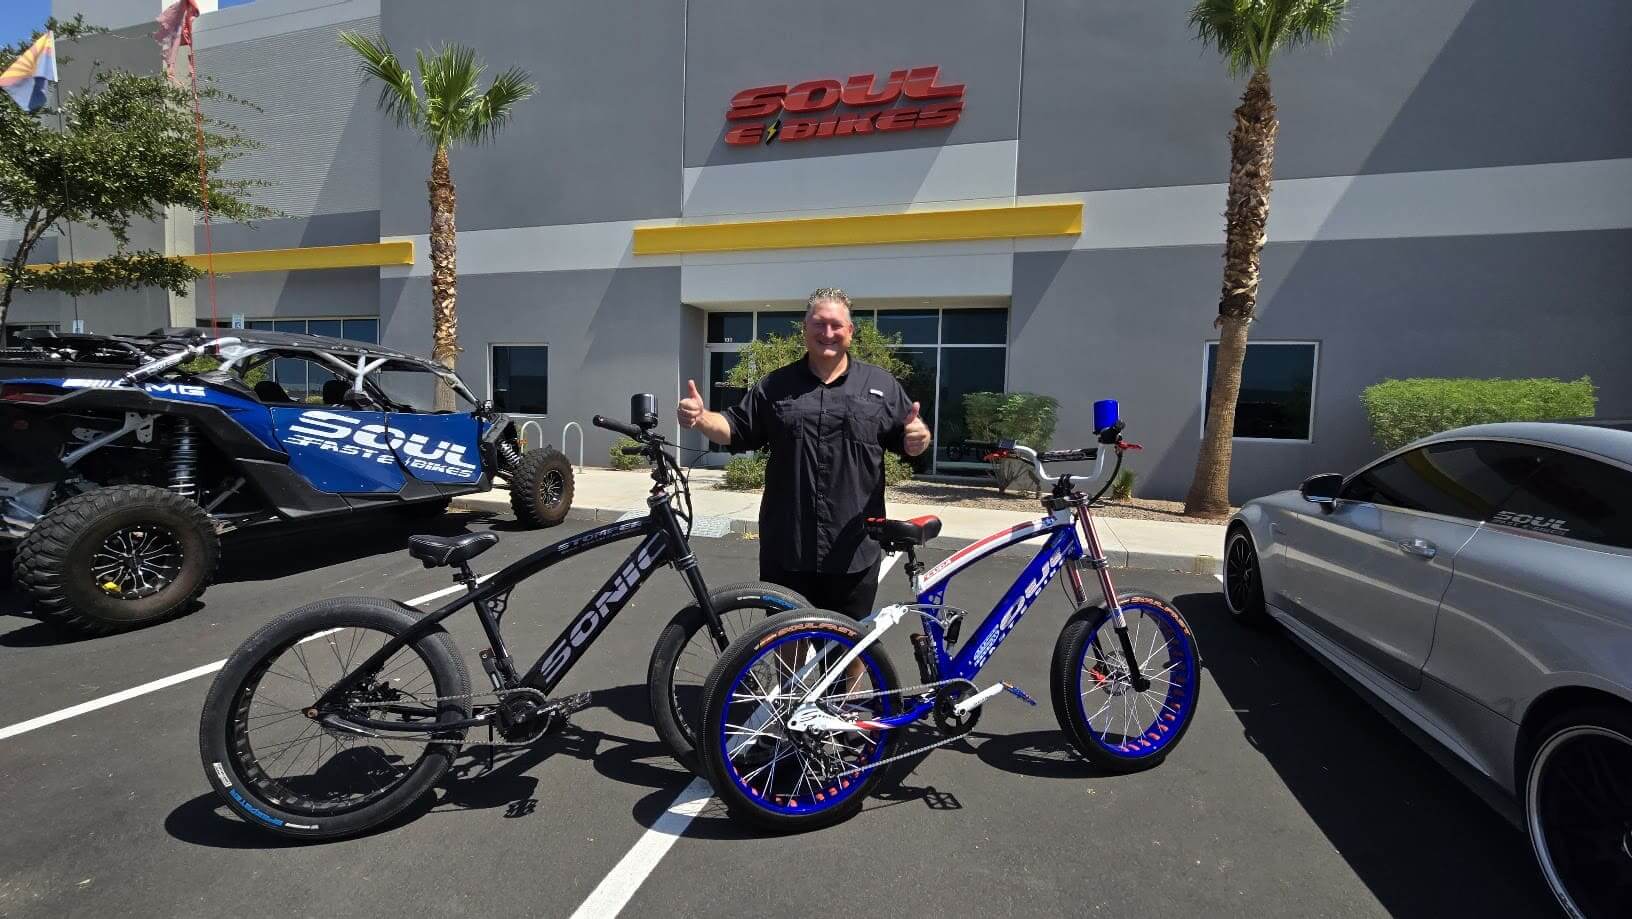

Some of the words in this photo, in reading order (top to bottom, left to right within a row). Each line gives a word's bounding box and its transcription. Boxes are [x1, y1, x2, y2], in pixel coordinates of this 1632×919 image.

[726, 65, 967, 121] SOUL
[779, 101, 965, 142] BIKES
[289, 410, 476, 470] SOUL
[411, 458, 473, 478] BIKES
[1493, 510, 1571, 532] SOUL
[540, 531, 668, 684] SONIC
